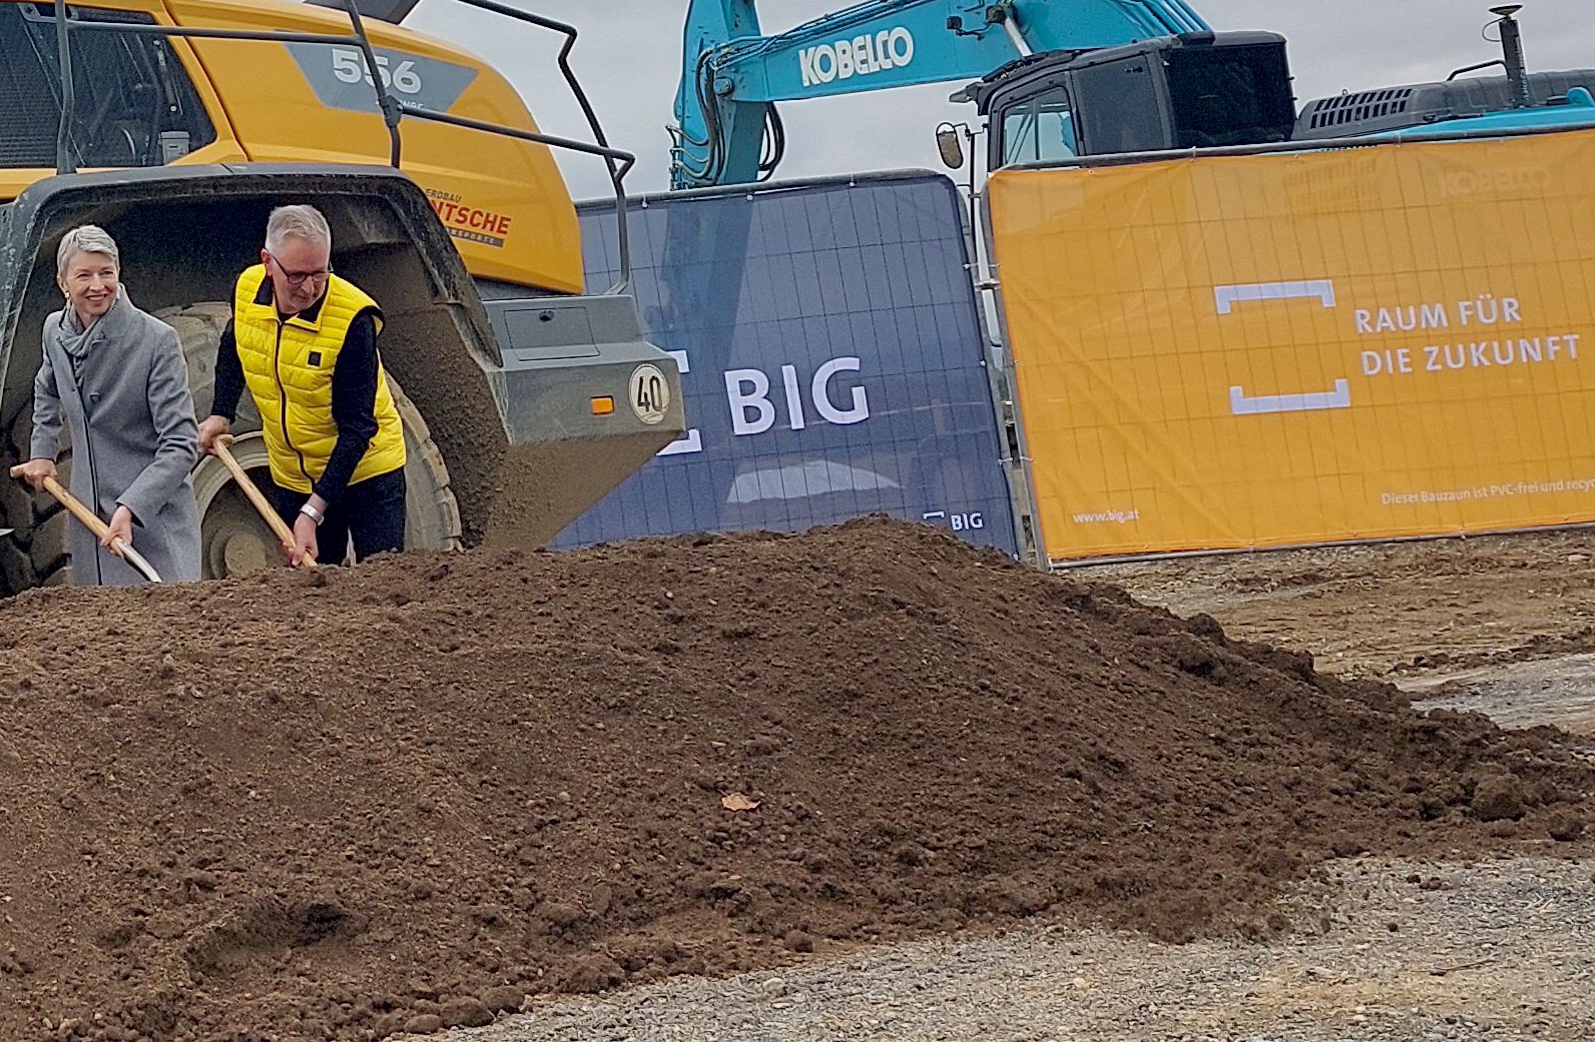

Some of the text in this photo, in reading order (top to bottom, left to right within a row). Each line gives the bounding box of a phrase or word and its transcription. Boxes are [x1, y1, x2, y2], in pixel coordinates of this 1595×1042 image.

[332, 48, 422, 94] 556
[798, 26, 914, 87] KOBELCO
[425, 188, 462, 203] ERDBAU
[1355, 293, 1522, 334] RAUM FÜR
[1361, 334, 1580, 376] DIE ZUKUNFT
[638, 375, 662, 412] 40
[724, 356, 870, 436] BIG
[1381, 492, 1418, 505] Dieser
[1420, 489, 1470, 503] Bauzaun
[1473, 486, 1488, 499] ist
[1491, 483, 1538, 497] PVC-frei
[1541, 480, 1564, 493] und
[950, 512, 984, 532] BIG
[1071, 508, 1140, 524] www.big.at
